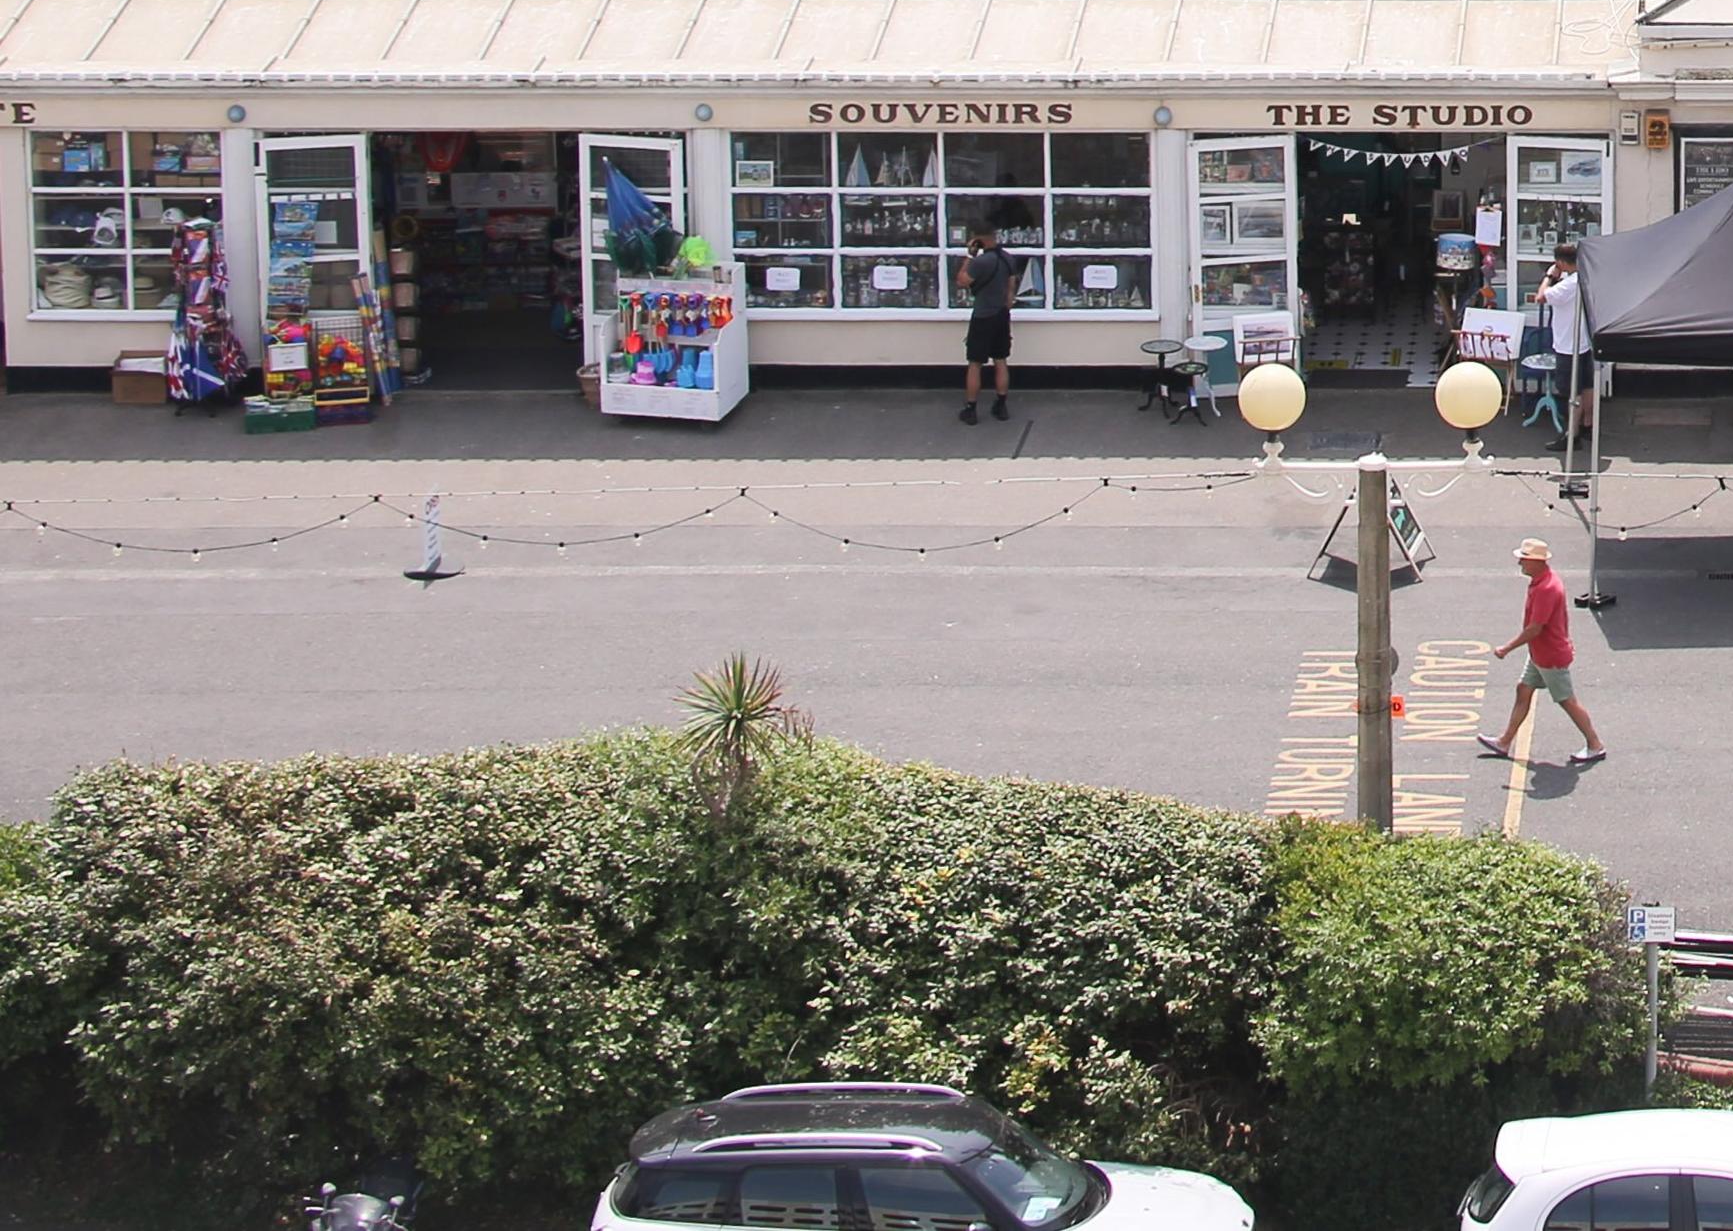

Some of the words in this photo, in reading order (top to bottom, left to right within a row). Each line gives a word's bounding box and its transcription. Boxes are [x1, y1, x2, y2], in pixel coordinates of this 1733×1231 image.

[809, 103, 1073, 124] SOUVENIRS
[1266, 105, 1351, 126] THE
[1372, 105, 1533, 126] STUDIO
[1399, 640, 1491, 741] CAUTION
[1633, 910, 1644, 923] P
